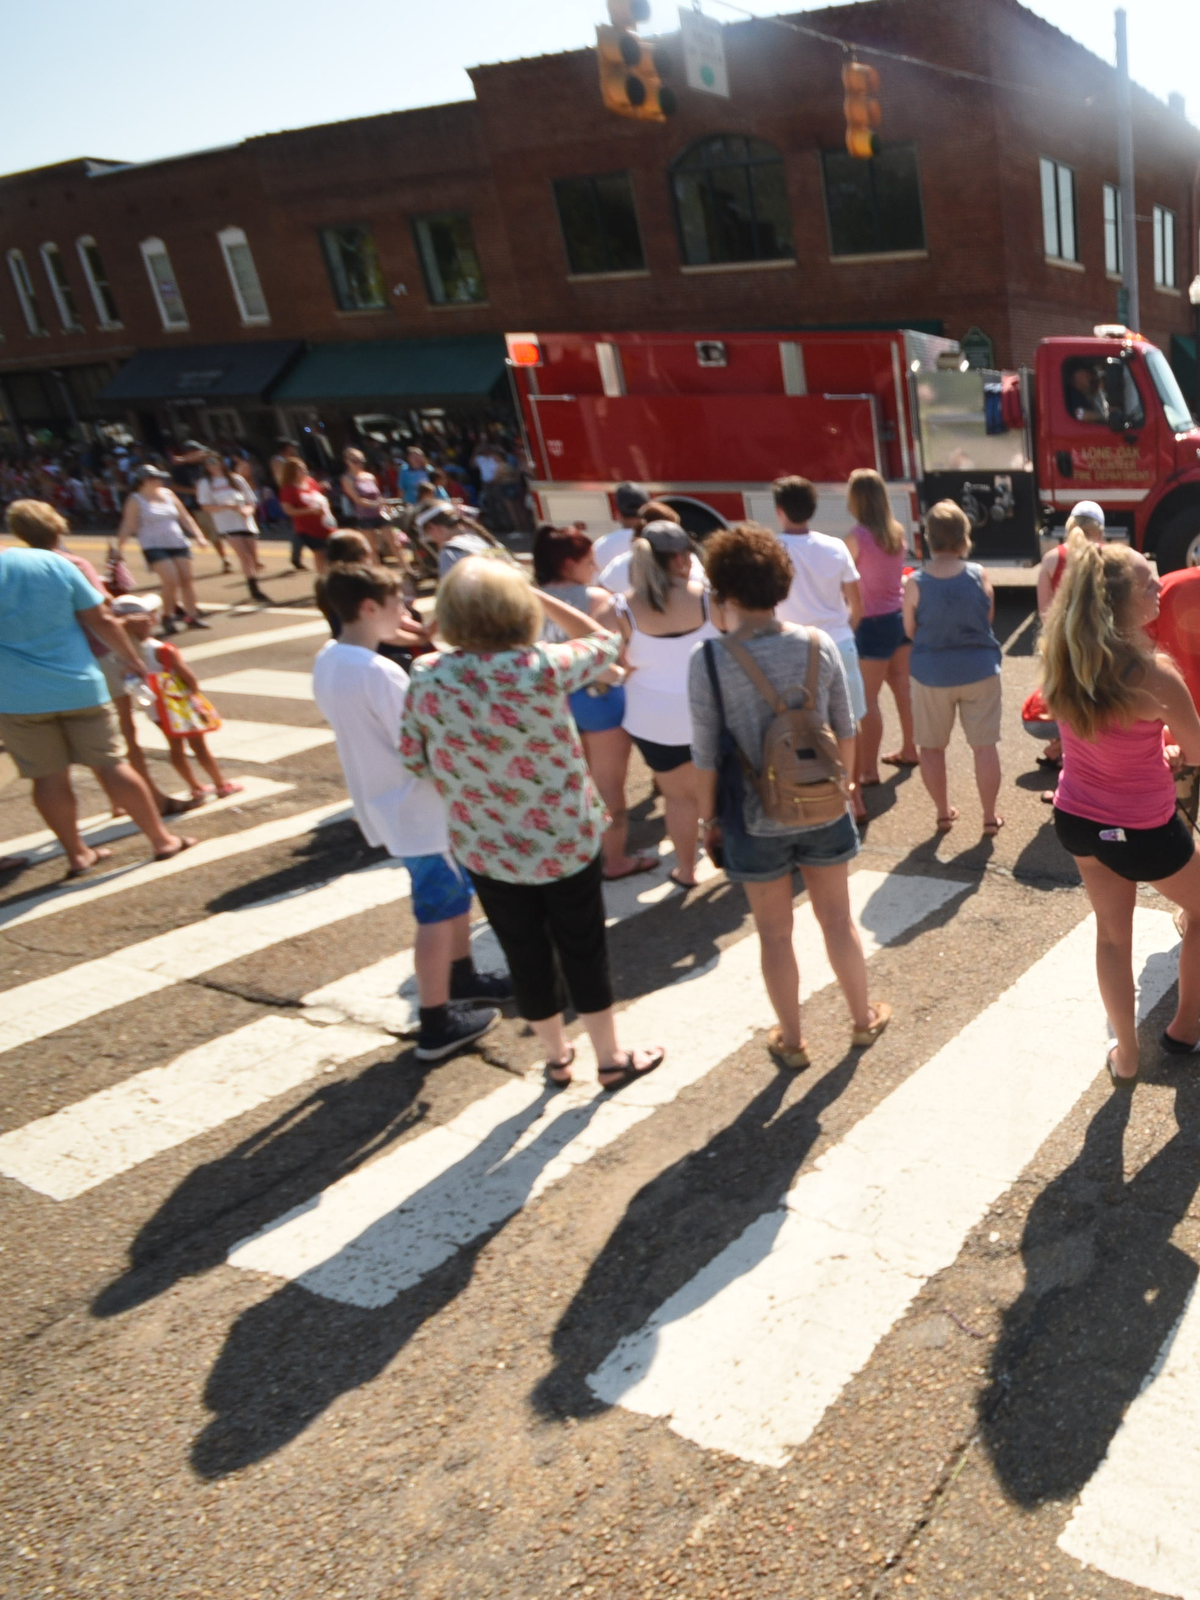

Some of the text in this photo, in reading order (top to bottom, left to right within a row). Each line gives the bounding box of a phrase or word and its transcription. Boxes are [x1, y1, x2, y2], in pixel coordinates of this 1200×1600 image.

[1082, 447, 1140, 459] LONE OAK
[1074, 471, 1149, 480] FIRE DEPARTMENT
